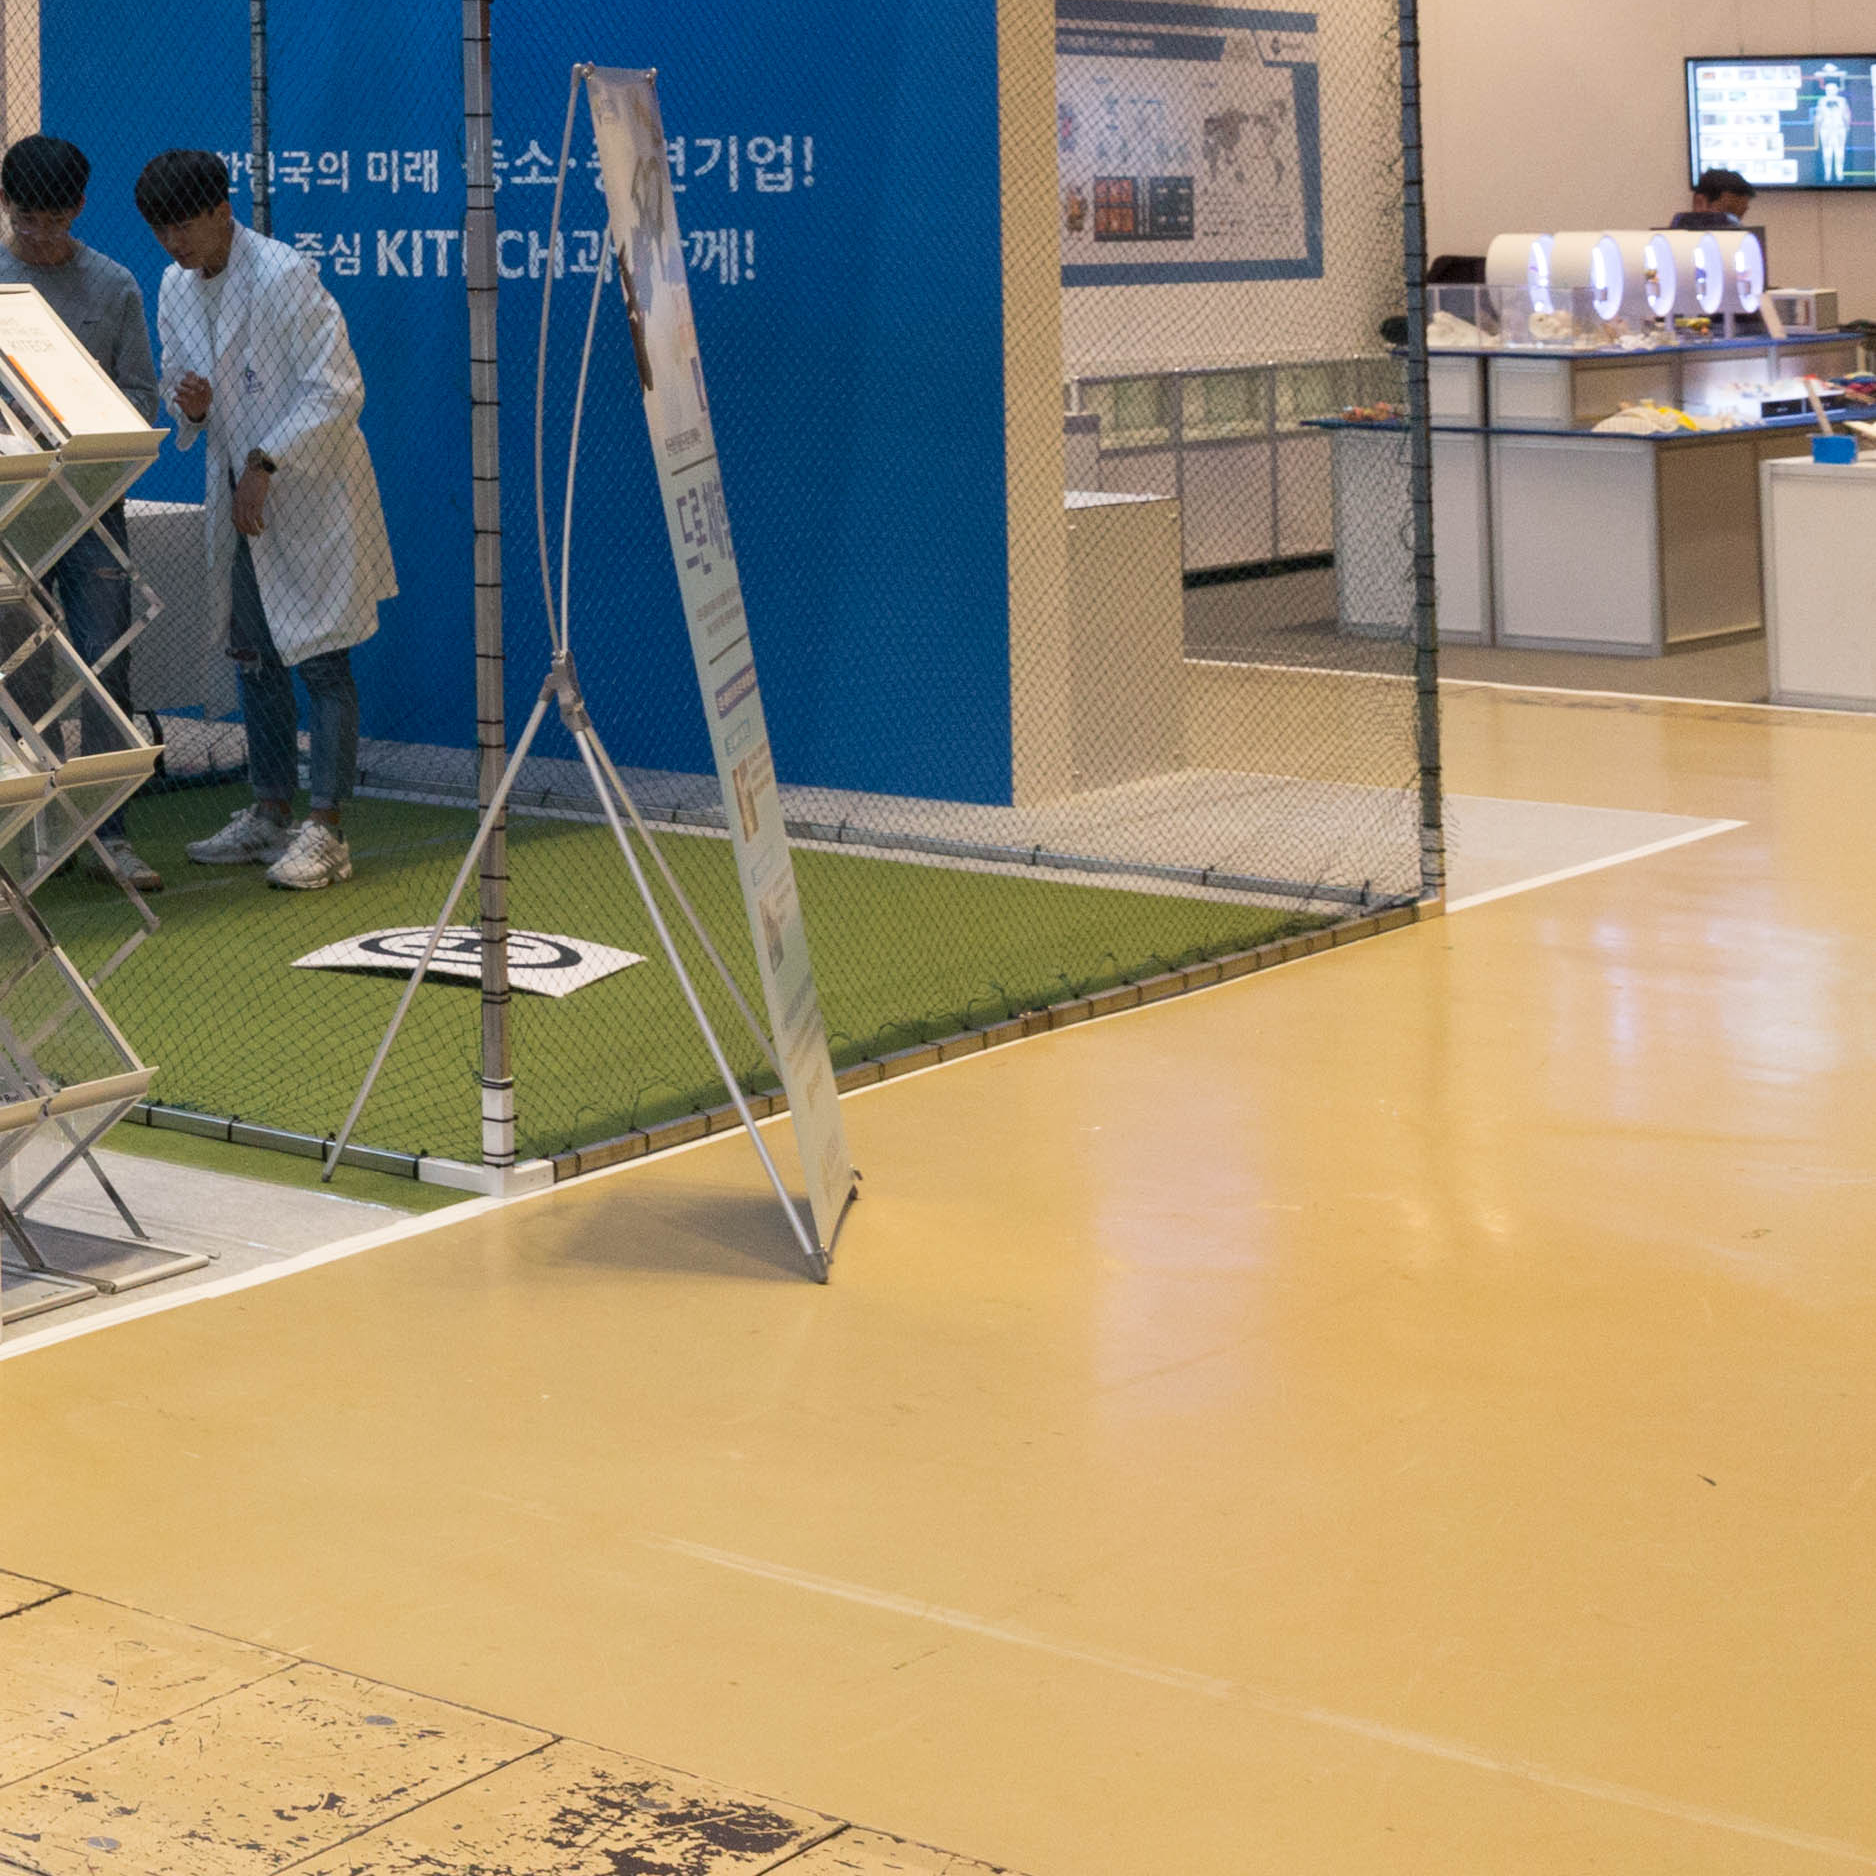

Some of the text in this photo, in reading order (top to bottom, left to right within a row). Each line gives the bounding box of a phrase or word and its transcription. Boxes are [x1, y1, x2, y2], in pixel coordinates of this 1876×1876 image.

[367, 149, 439, 194] 미래
[376, 227, 618, 285] KITCH과
[682, 227, 756, 286] 께!
